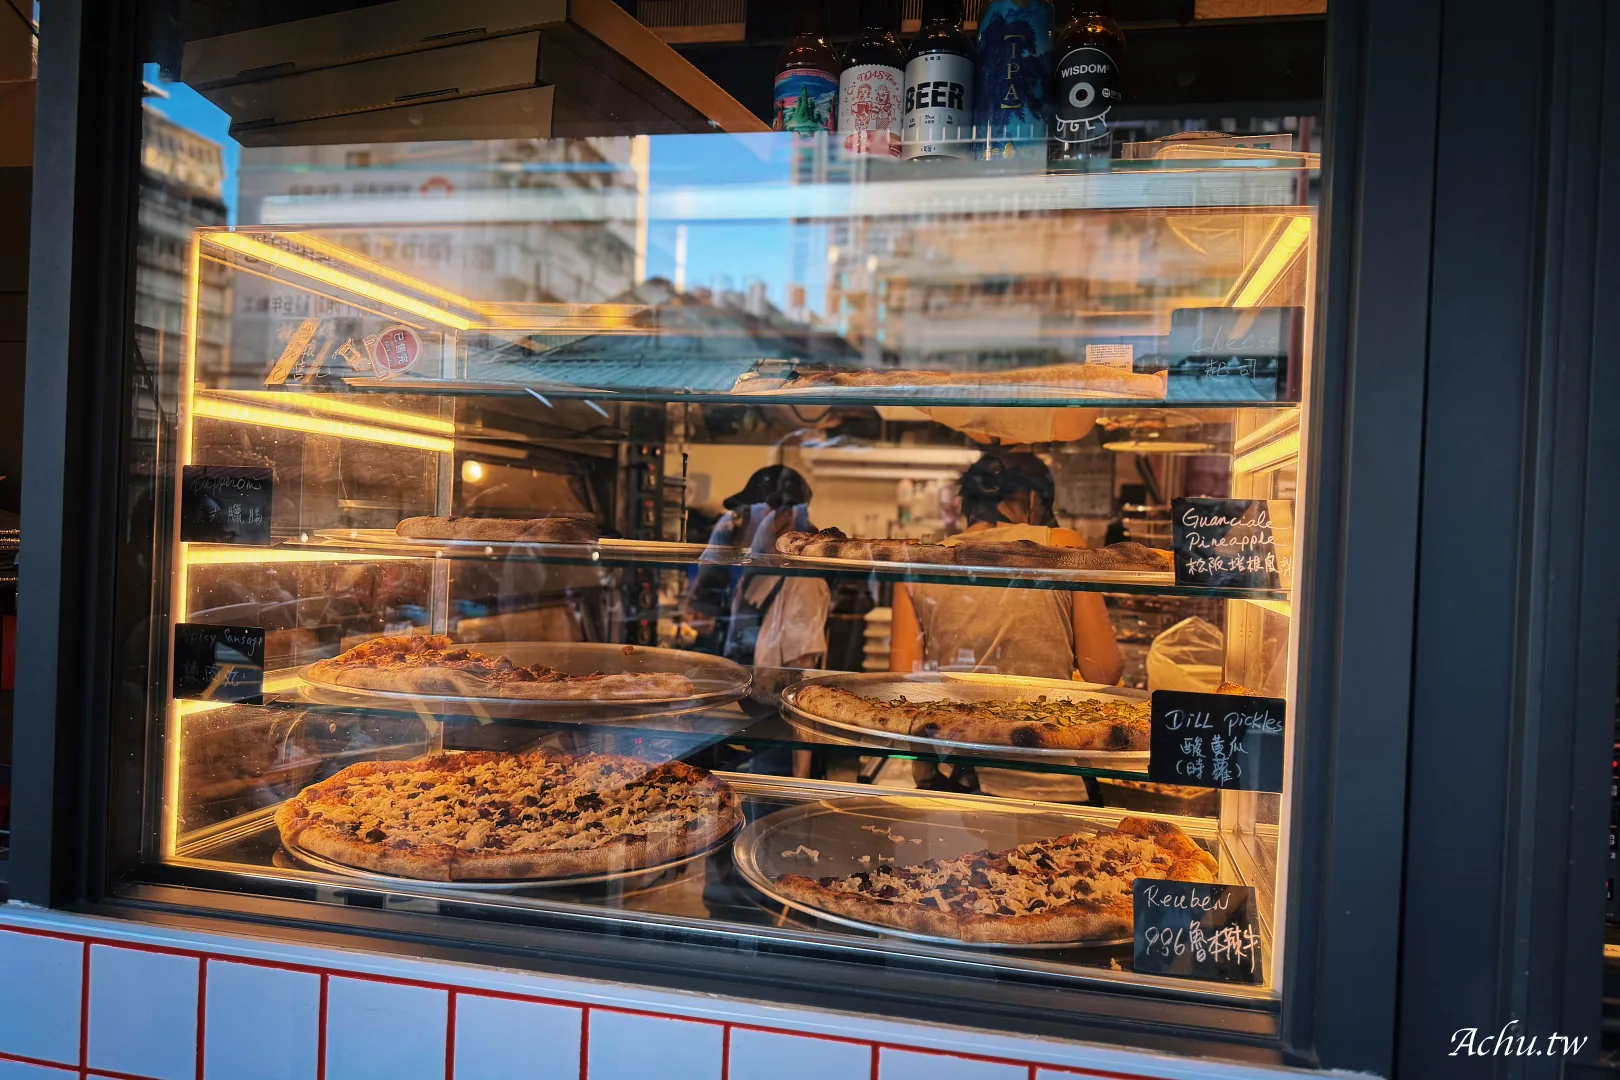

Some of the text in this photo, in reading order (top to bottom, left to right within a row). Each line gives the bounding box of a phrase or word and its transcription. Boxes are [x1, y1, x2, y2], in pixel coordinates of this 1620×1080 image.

[1003, 41, 1021, 101] IPA
[1061, 63, 1107, 78] WISDOM
[905, 81, 965, 116] BEER
[1205, 358, 1256, 383] 起司
[1182, 507, 1292, 530] Guanciale
[1186, 532, 1287, 551] Pineapple
